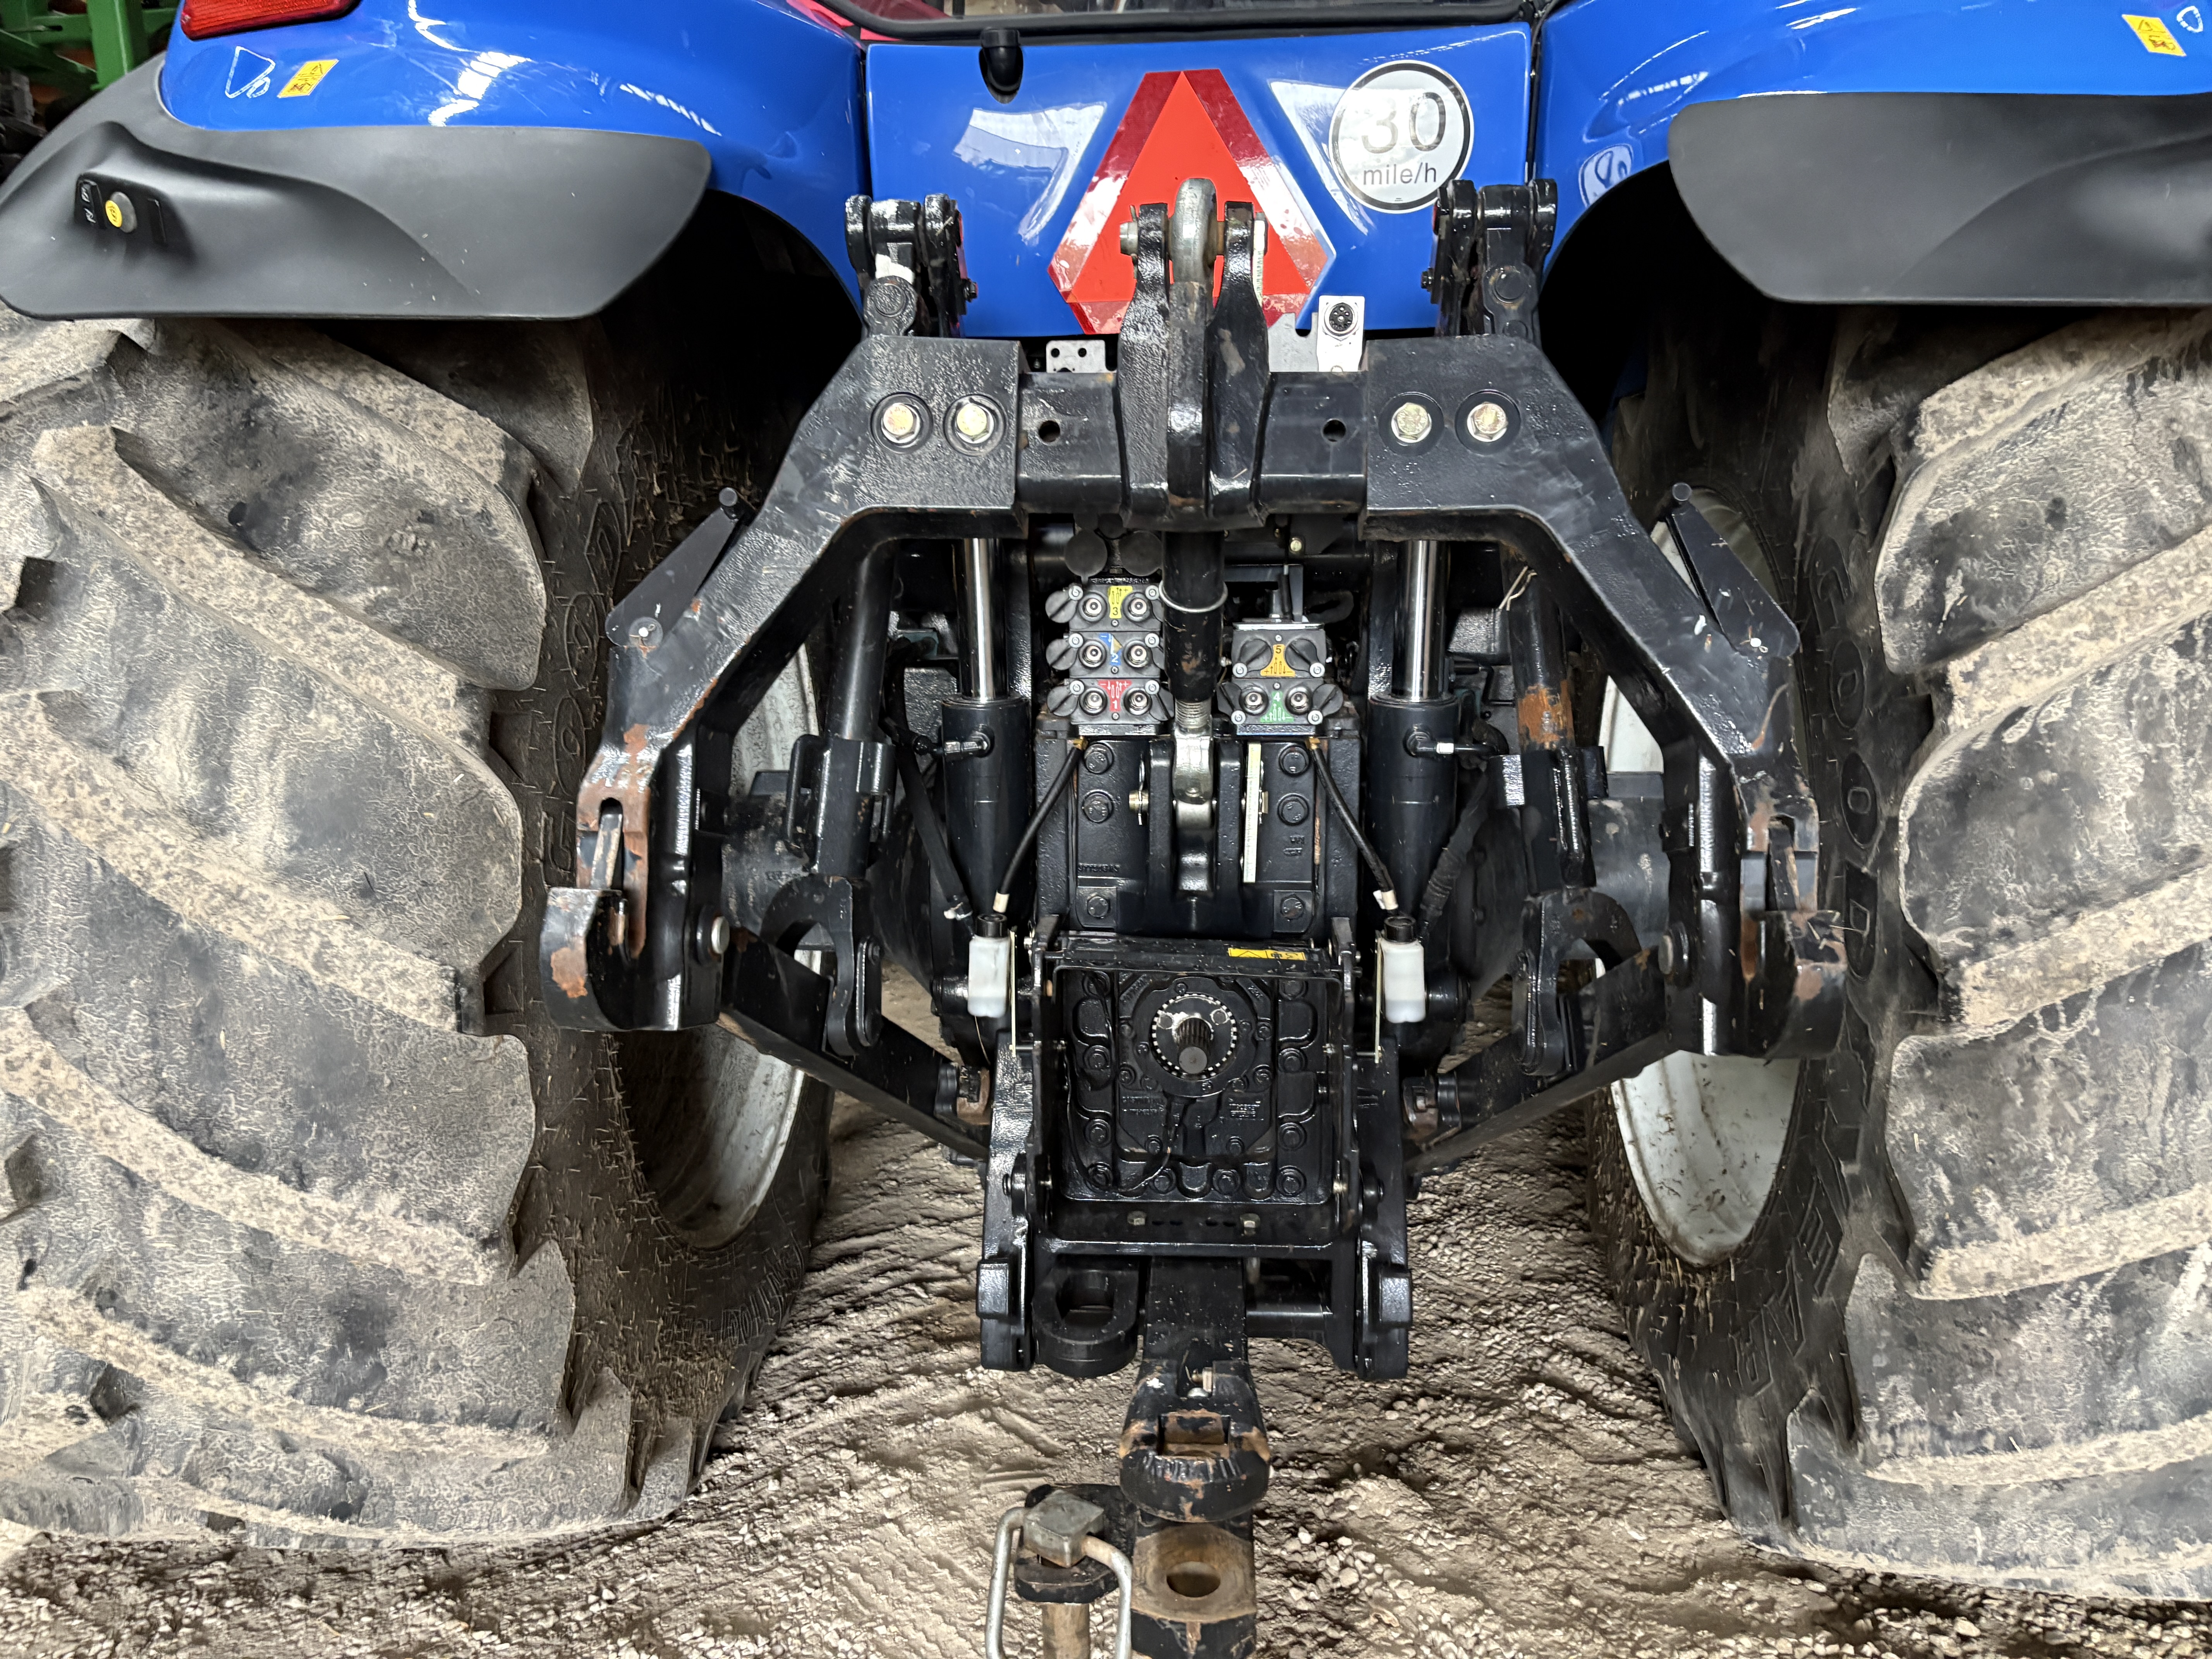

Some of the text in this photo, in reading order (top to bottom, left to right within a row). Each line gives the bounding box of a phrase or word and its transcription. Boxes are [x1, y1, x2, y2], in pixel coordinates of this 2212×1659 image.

[1362, 92, 1446, 154] 30
[1363, 162, 1437, 185] mile/h
[1113, 607, 1118, 616] 3
[1275, 646, 1282, 654] 5
[1111, 654, 1119, 663] 2
[1273, 692, 1281, 702] 4
[1112, 700, 1118, 709] 1
